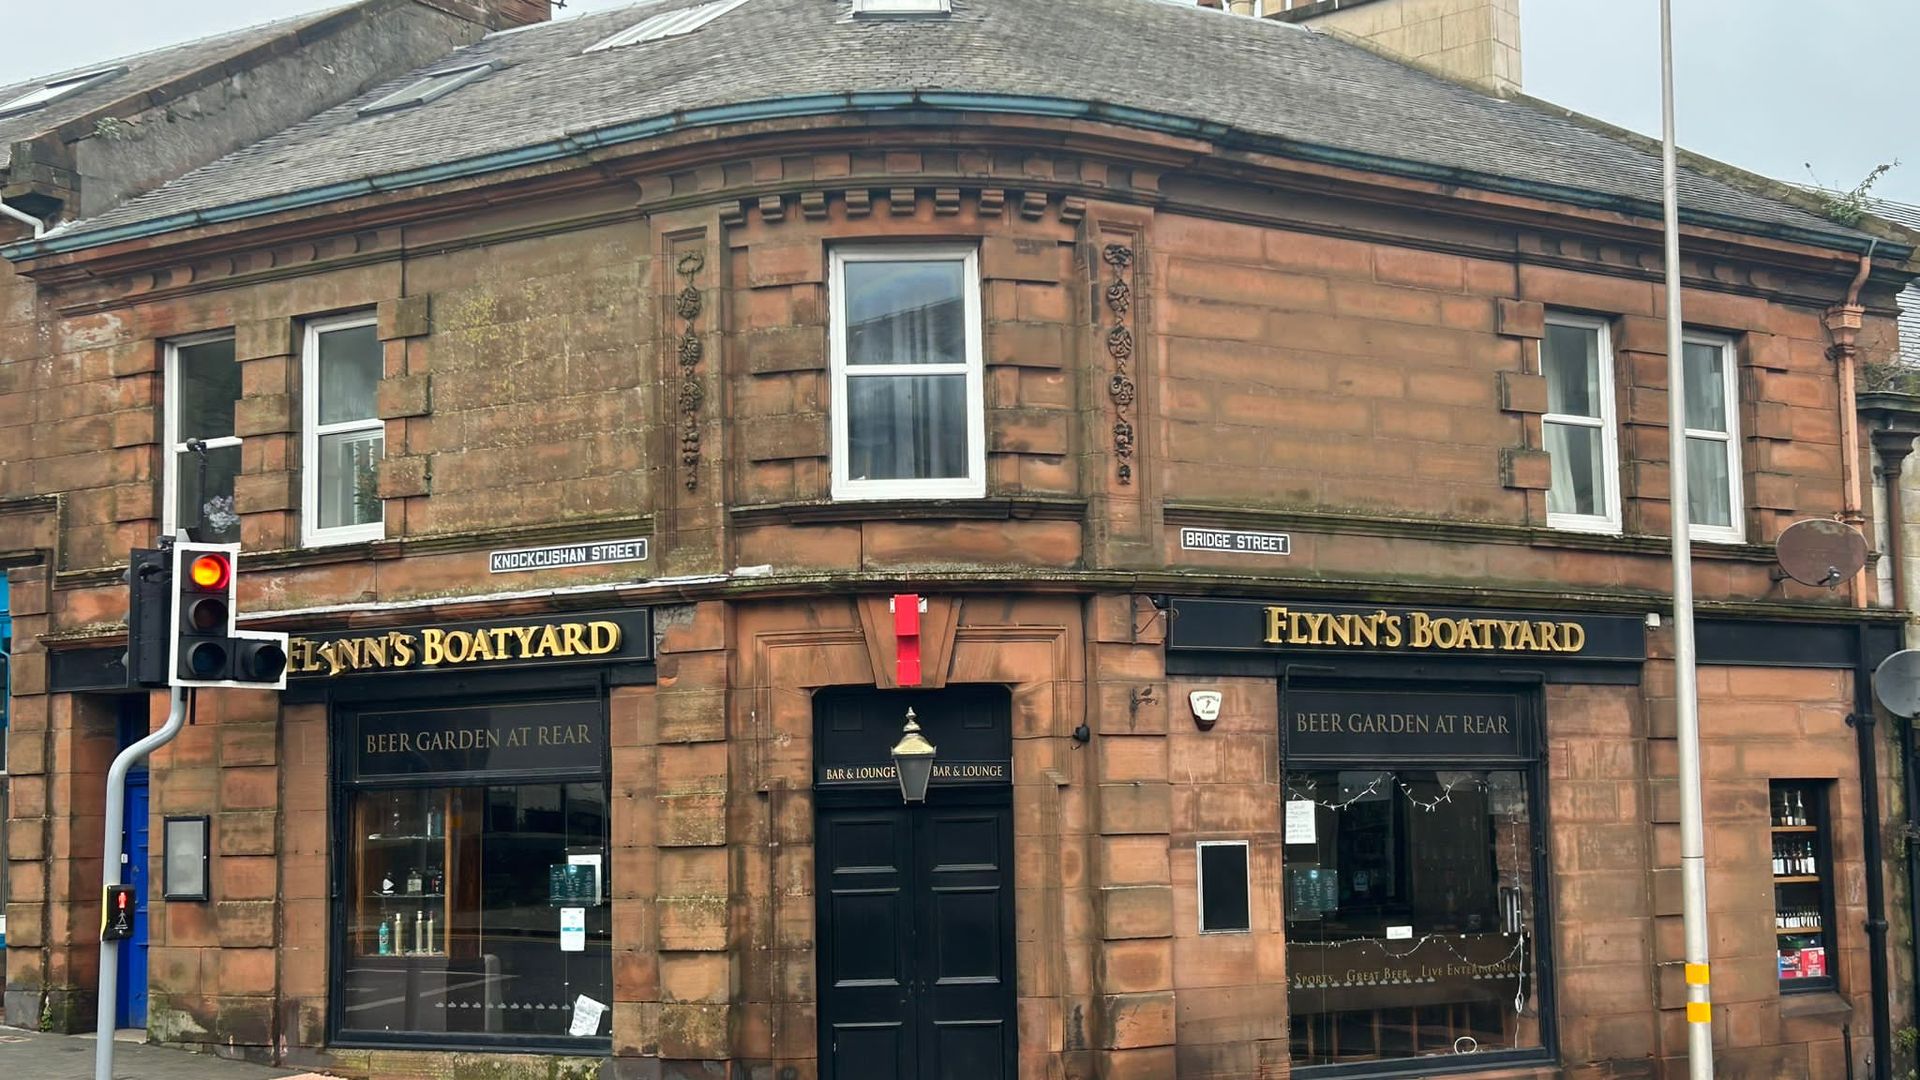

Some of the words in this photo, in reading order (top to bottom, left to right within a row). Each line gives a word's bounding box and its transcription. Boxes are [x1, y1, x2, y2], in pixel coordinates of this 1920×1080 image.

[1186, 531, 1231, 548] BRIDGE
[1237, 535, 1285, 551] STREET
[494, 548, 586, 569] KNOCKCUSHAN
[592, 543, 642, 561] STREET
[1264, 606, 1401, 647] FLYNN'S
[1408, 612, 1585, 652] BOATYARD
[288, 631, 417, 676] FLYNN'S
[421, 621, 621, 665] BOATYARD
[1297, 712, 1344, 733] BEER
[1348, 713, 1429, 734] GARDEN
[1435, 714, 1458, 733] AT
[1463, 715, 1510, 734] REAR
[366, 731, 412, 754] BEER
[416, 728, 500, 751] GARDEN
[506, 727, 531, 748] AT
[538, 724, 592, 745] REAR
[826, 767, 846, 780] BAR
[846, 767, 854, 779] &
[856, 766, 896, 779] LOUNGE
[933, 765, 951, 777] BAR
[952, 765, 960, 777] &
[962, 765, 1003, 777] LOUNGE
[1346, 968, 1380, 982] GREAT
[1422, 964, 1443, 977] LIVE
